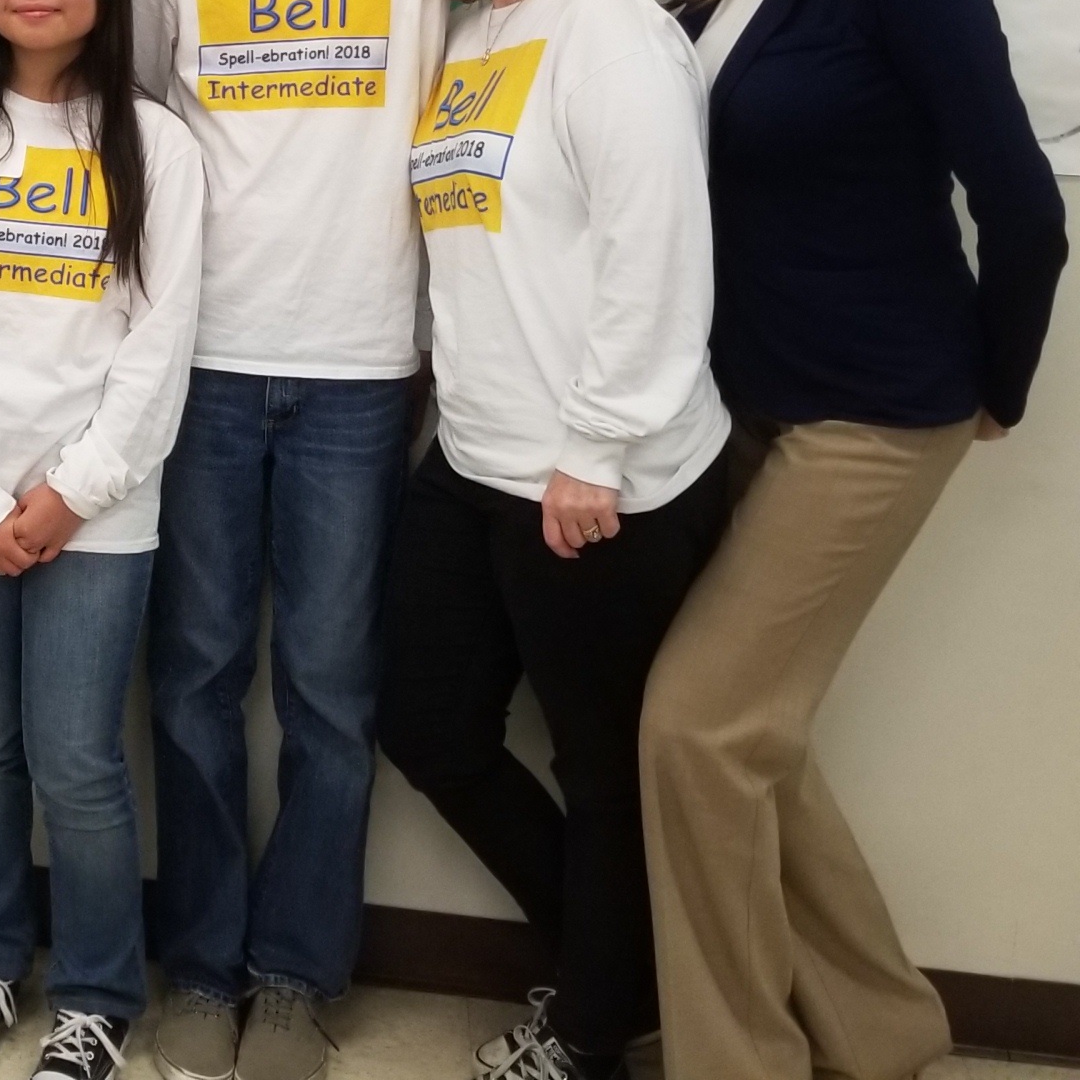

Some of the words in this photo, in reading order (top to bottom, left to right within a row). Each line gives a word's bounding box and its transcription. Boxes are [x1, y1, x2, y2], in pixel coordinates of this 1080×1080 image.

[218, 45, 330, 70] Spell-ebration!
[334, 45, 371, 60] 2018
[207, 73, 377, 101] Intermediate
[433, 67, 507, 133] Bell
